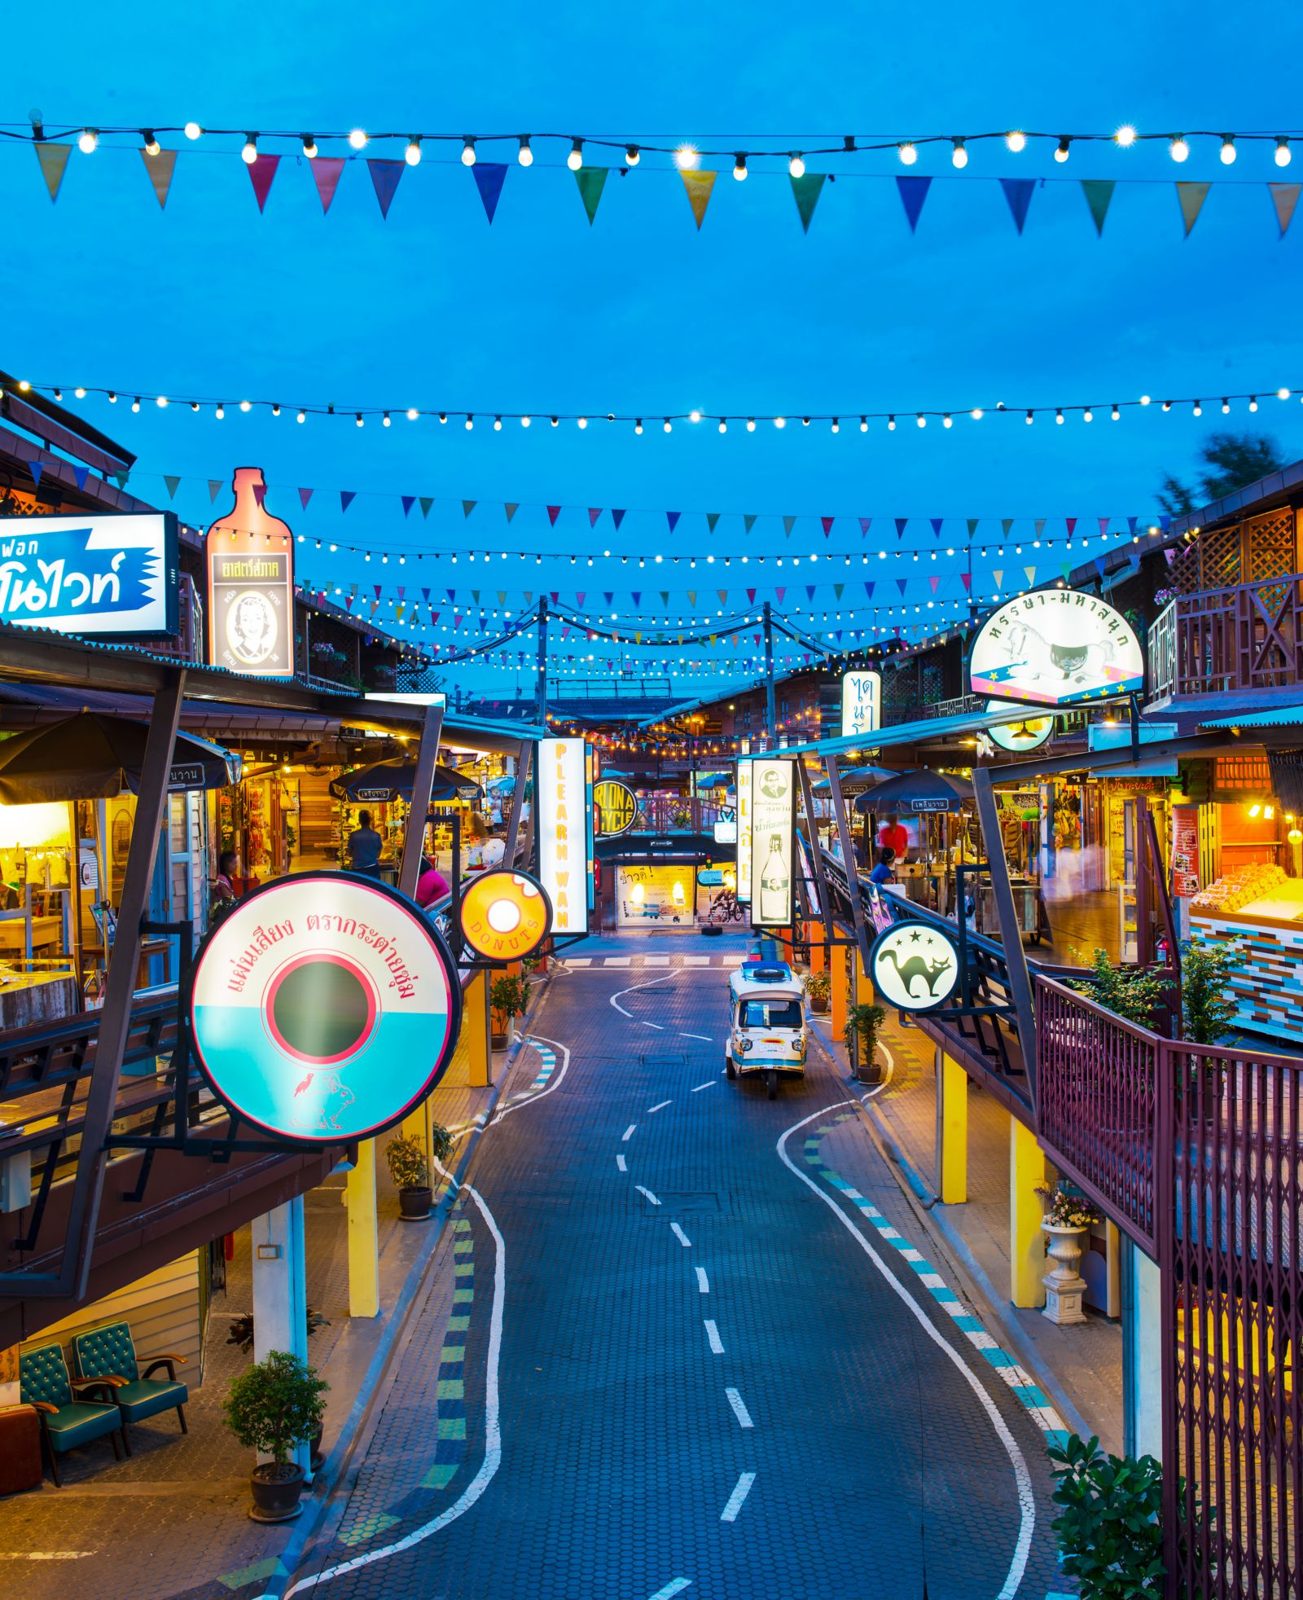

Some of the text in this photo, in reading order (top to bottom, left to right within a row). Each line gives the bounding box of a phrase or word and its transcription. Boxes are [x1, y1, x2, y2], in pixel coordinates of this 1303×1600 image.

[609, 784, 624, 809] ON
[625, 793, 633, 809] A
[555, 743, 569, 928] PLEARN WAN
[228, 920, 294, 992] แผ่นเสียง
[469, 919, 540, 950] DONUTS
